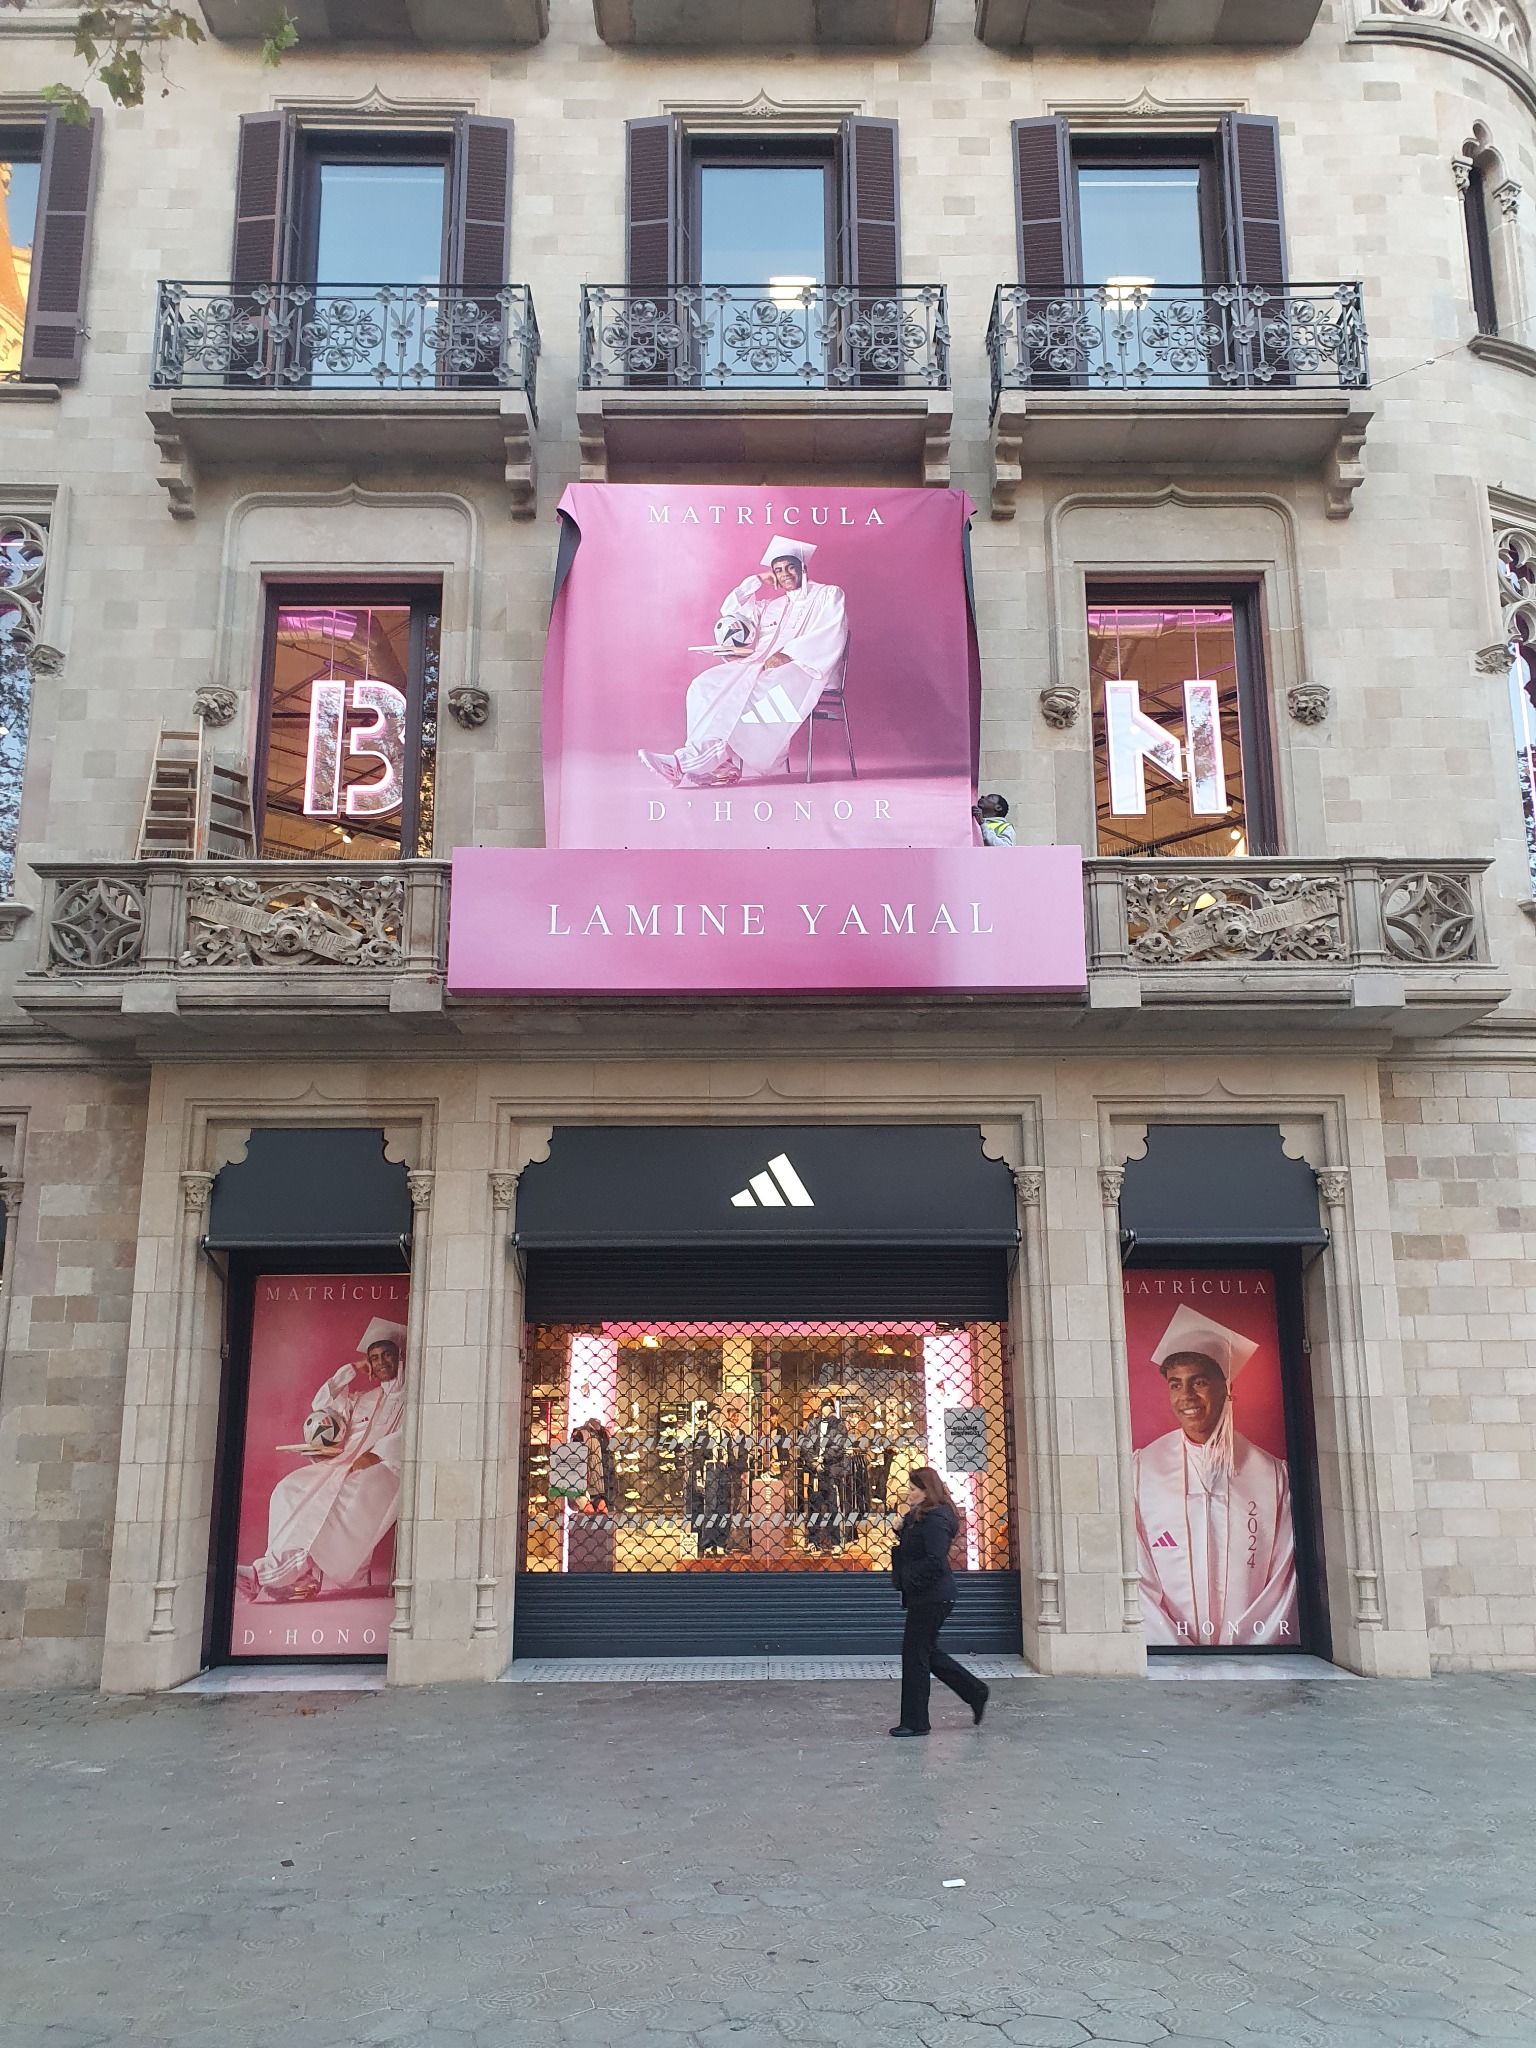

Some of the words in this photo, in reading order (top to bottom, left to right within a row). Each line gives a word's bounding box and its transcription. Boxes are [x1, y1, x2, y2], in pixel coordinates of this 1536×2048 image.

[648, 502, 885, 526] MATRÍCULA
[648, 799, 892, 822] D'HONOR
[548, 904, 765, 936] LAMINE
[797, 902, 994, 936] YAMAL
[265, 1282, 410, 1301] MATRÍCUL
[1247, 1500, 1258, 1569] 2024
[243, 1628, 377, 1646] D'HONO
